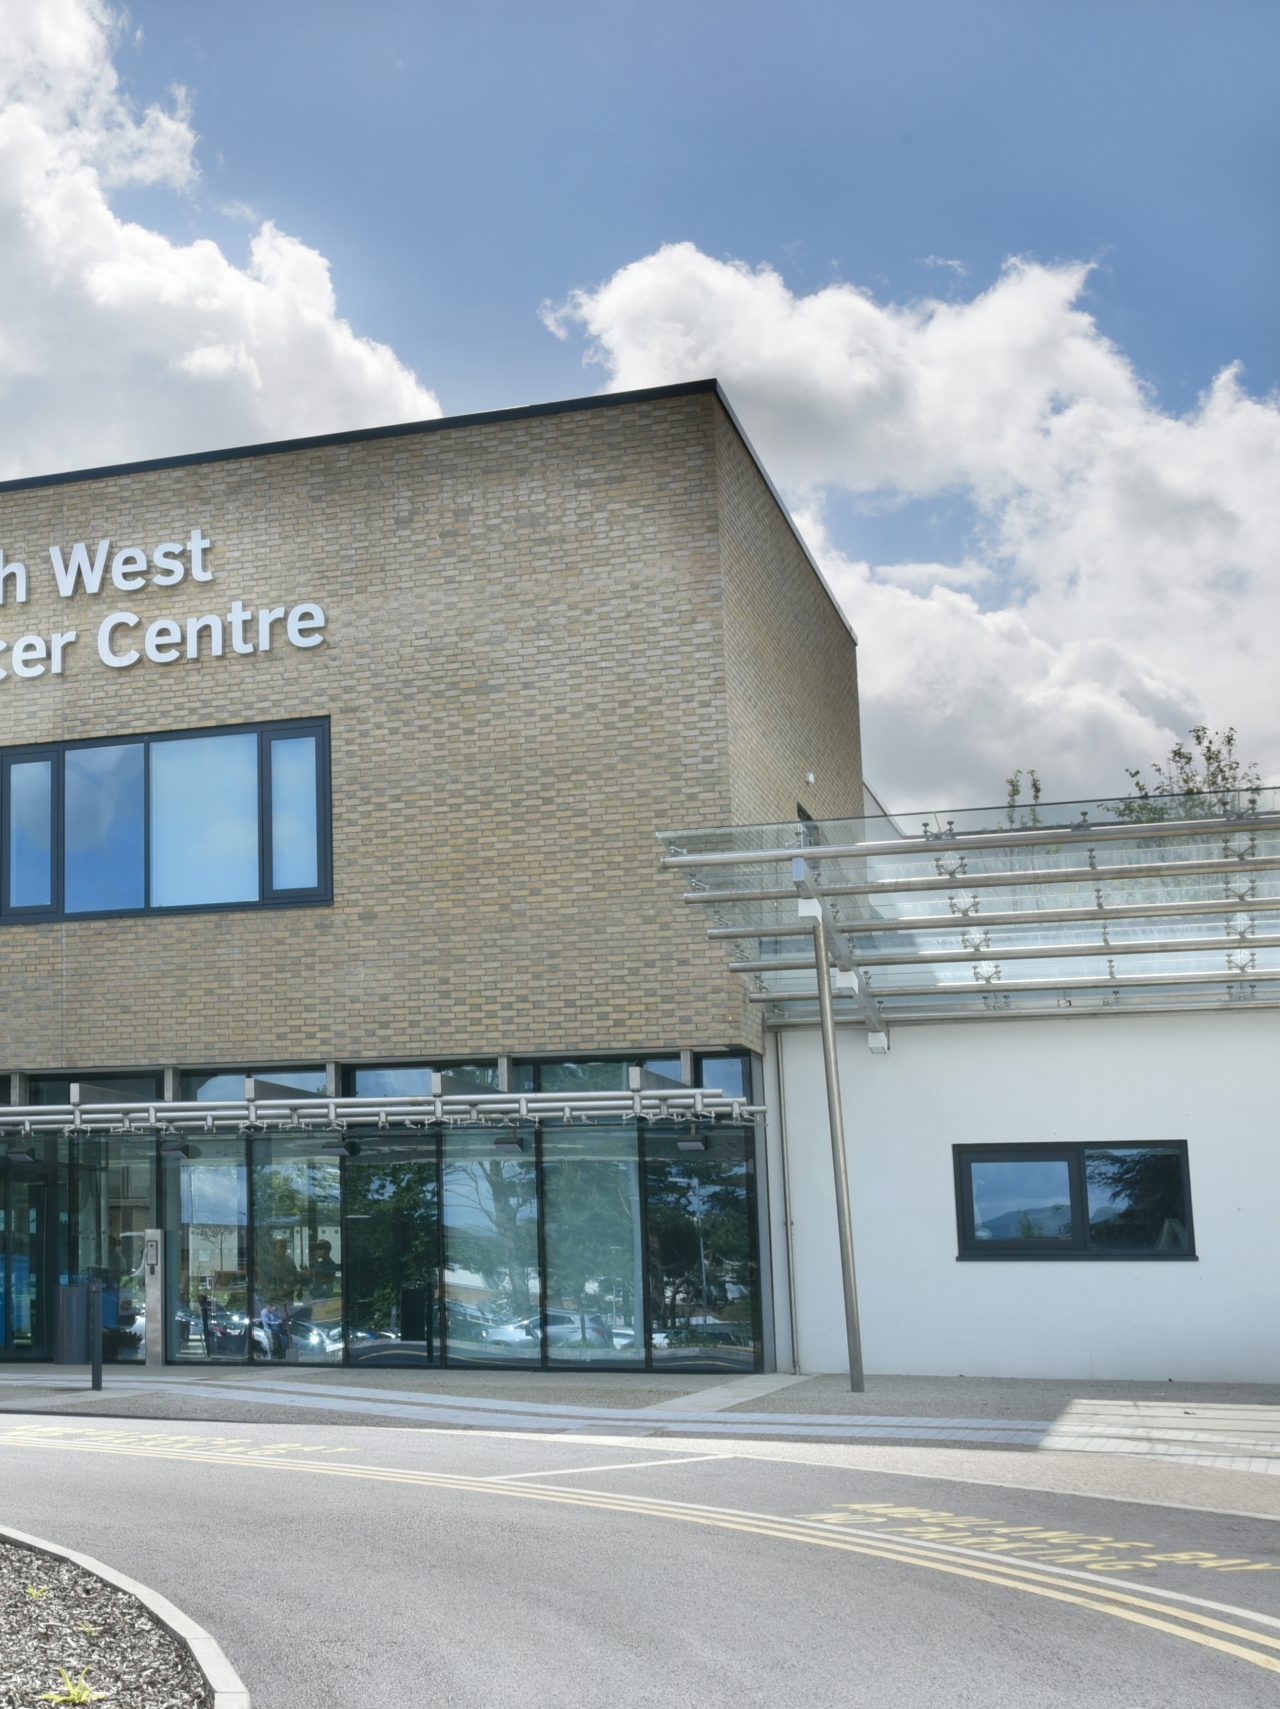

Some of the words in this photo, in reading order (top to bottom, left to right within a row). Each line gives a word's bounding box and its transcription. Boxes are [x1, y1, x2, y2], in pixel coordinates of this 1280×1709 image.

[49, 528, 214, 598] West
[97, 599, 325, 668] Centre
[794, 1512, 887, 1524] NO
[876, 1526, 1158, 1570] PARKING
[831, 1502, 1155, 1549] AMBULANCE
[1141, 1551, 1280, 1571] BAY
